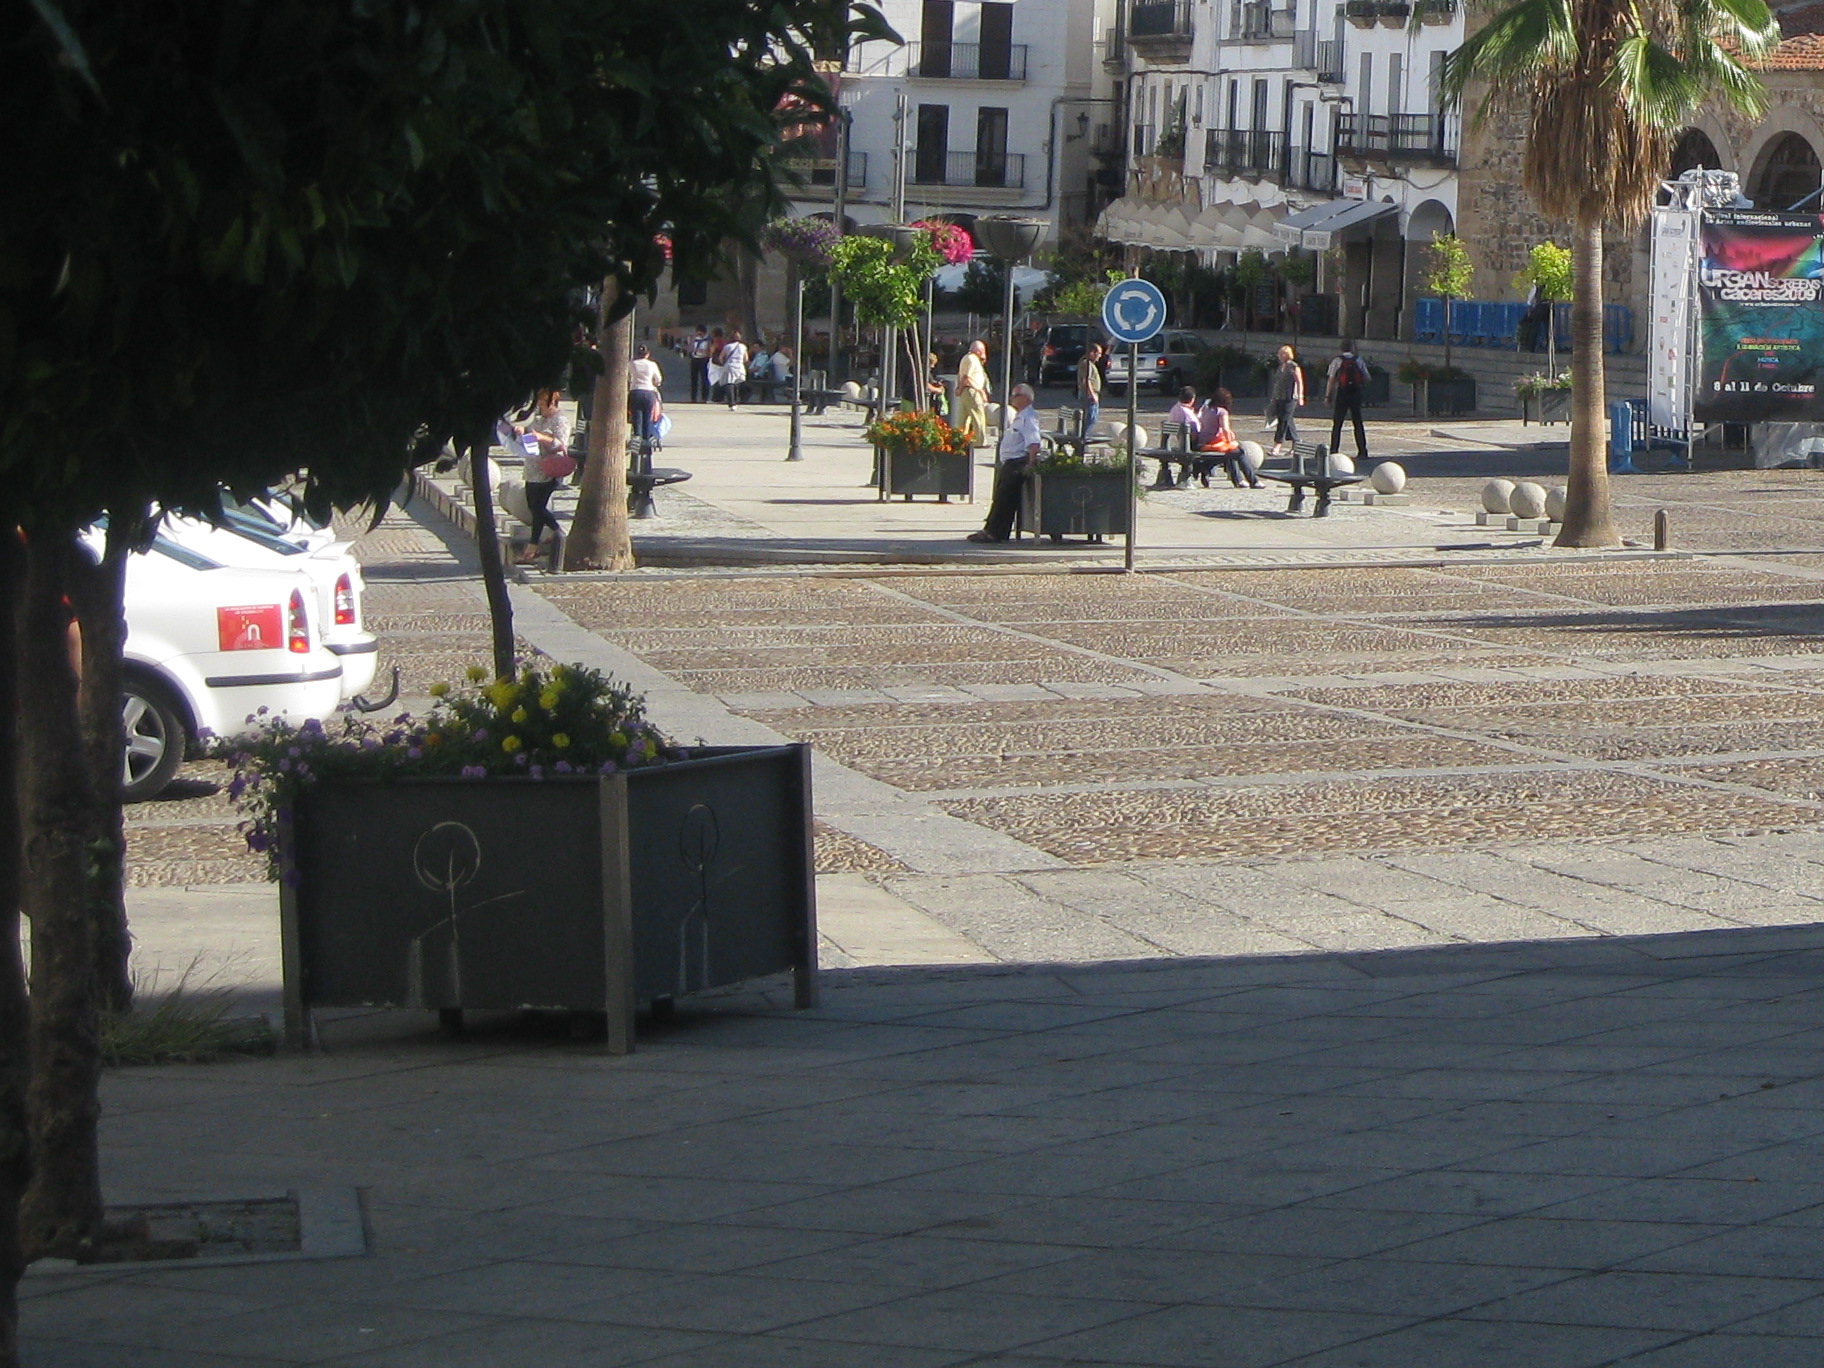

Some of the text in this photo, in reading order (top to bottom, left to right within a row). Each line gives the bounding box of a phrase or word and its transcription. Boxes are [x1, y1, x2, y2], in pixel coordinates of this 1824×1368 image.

[1770, 278, 1821, 290] SCREENS
[1713, 381, 1721, 391] 8
[1724, 381, 1736, 391] al
[1754, 382, 1768, 392] de
[1772, 382, 1815, 393] Octubre
